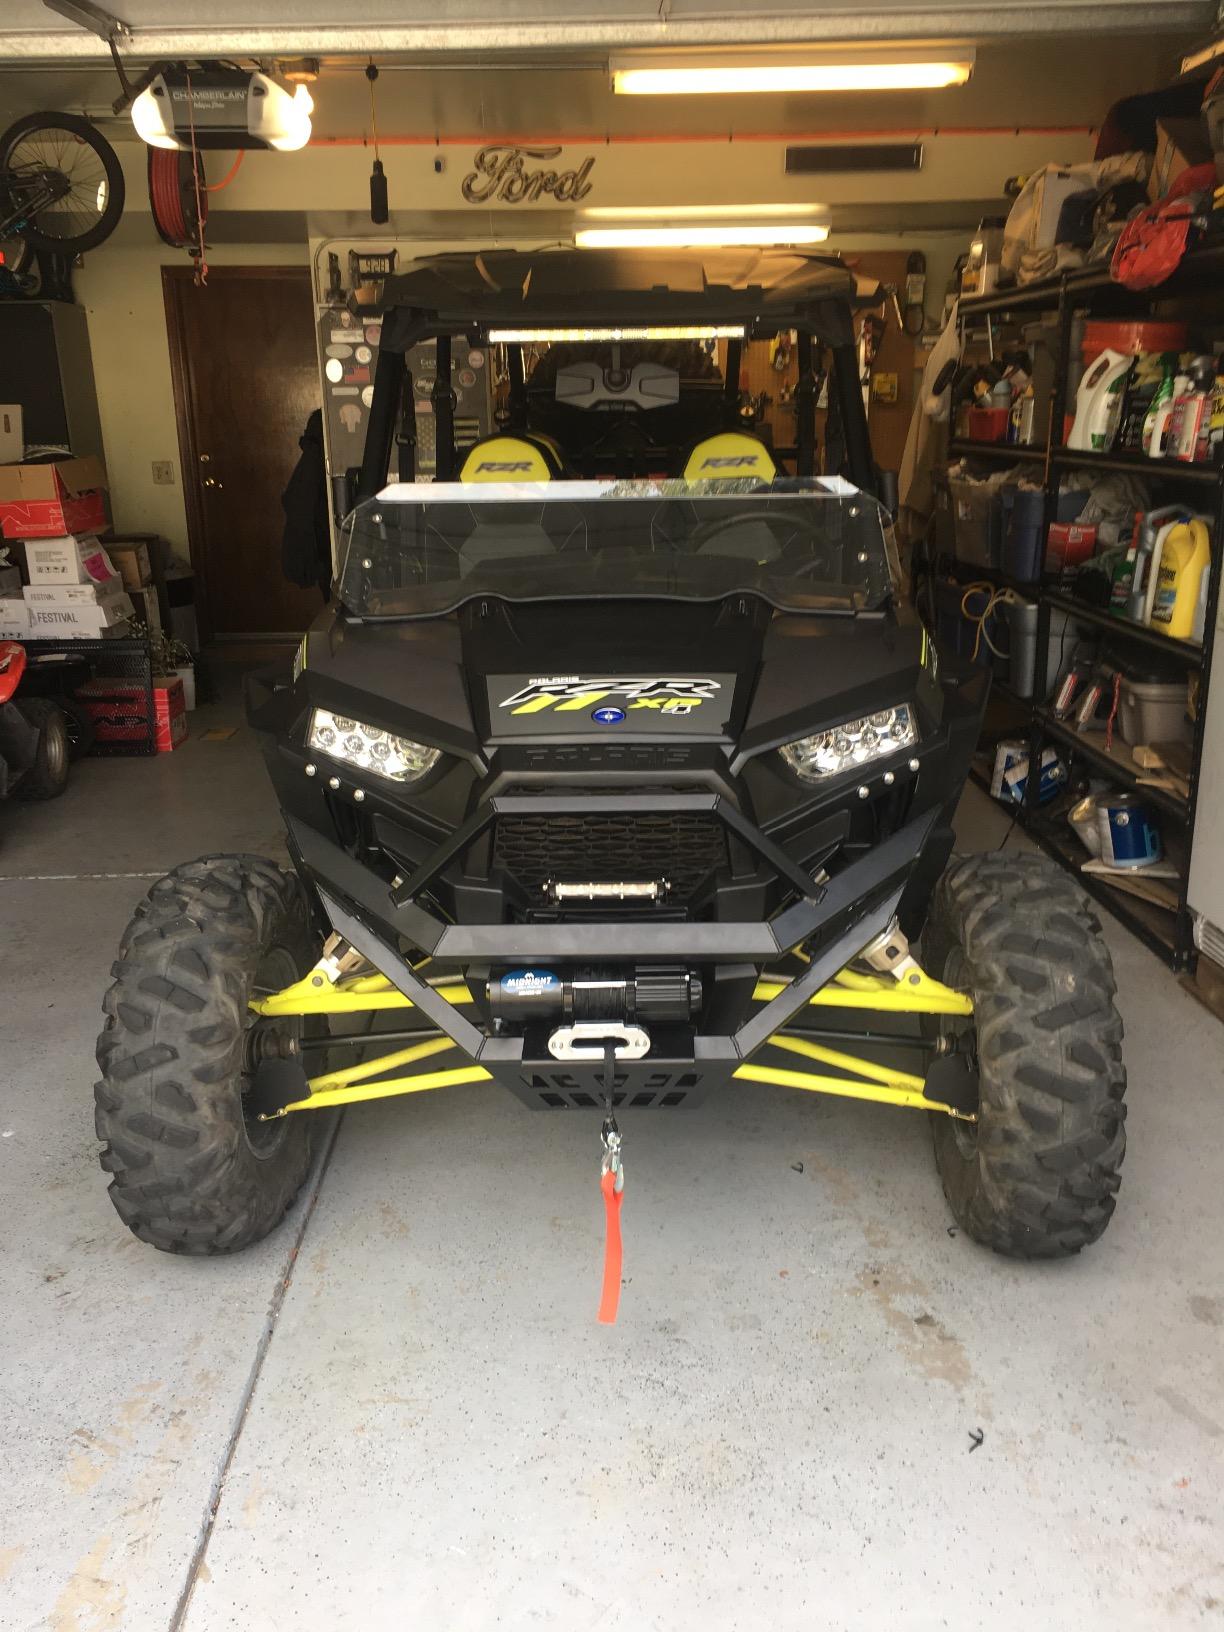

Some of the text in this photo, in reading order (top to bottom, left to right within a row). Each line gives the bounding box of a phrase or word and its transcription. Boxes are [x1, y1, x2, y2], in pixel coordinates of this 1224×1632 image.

[172, 90, 245, 100] CHAMBERLAIN
[461, 145, 596, 203] Ford
[474, 461, 534, 474] RZR
[700, 455, 759, 470] RZR
[30, 593, 56, 601] FESTIVAL
[36, 612, 79, 624] FESTIVAL
[528, 675, 580, 685] POLARIS
[498, 678, 722, 708] RZR
[525, 746, 692, 768] POLARIS
